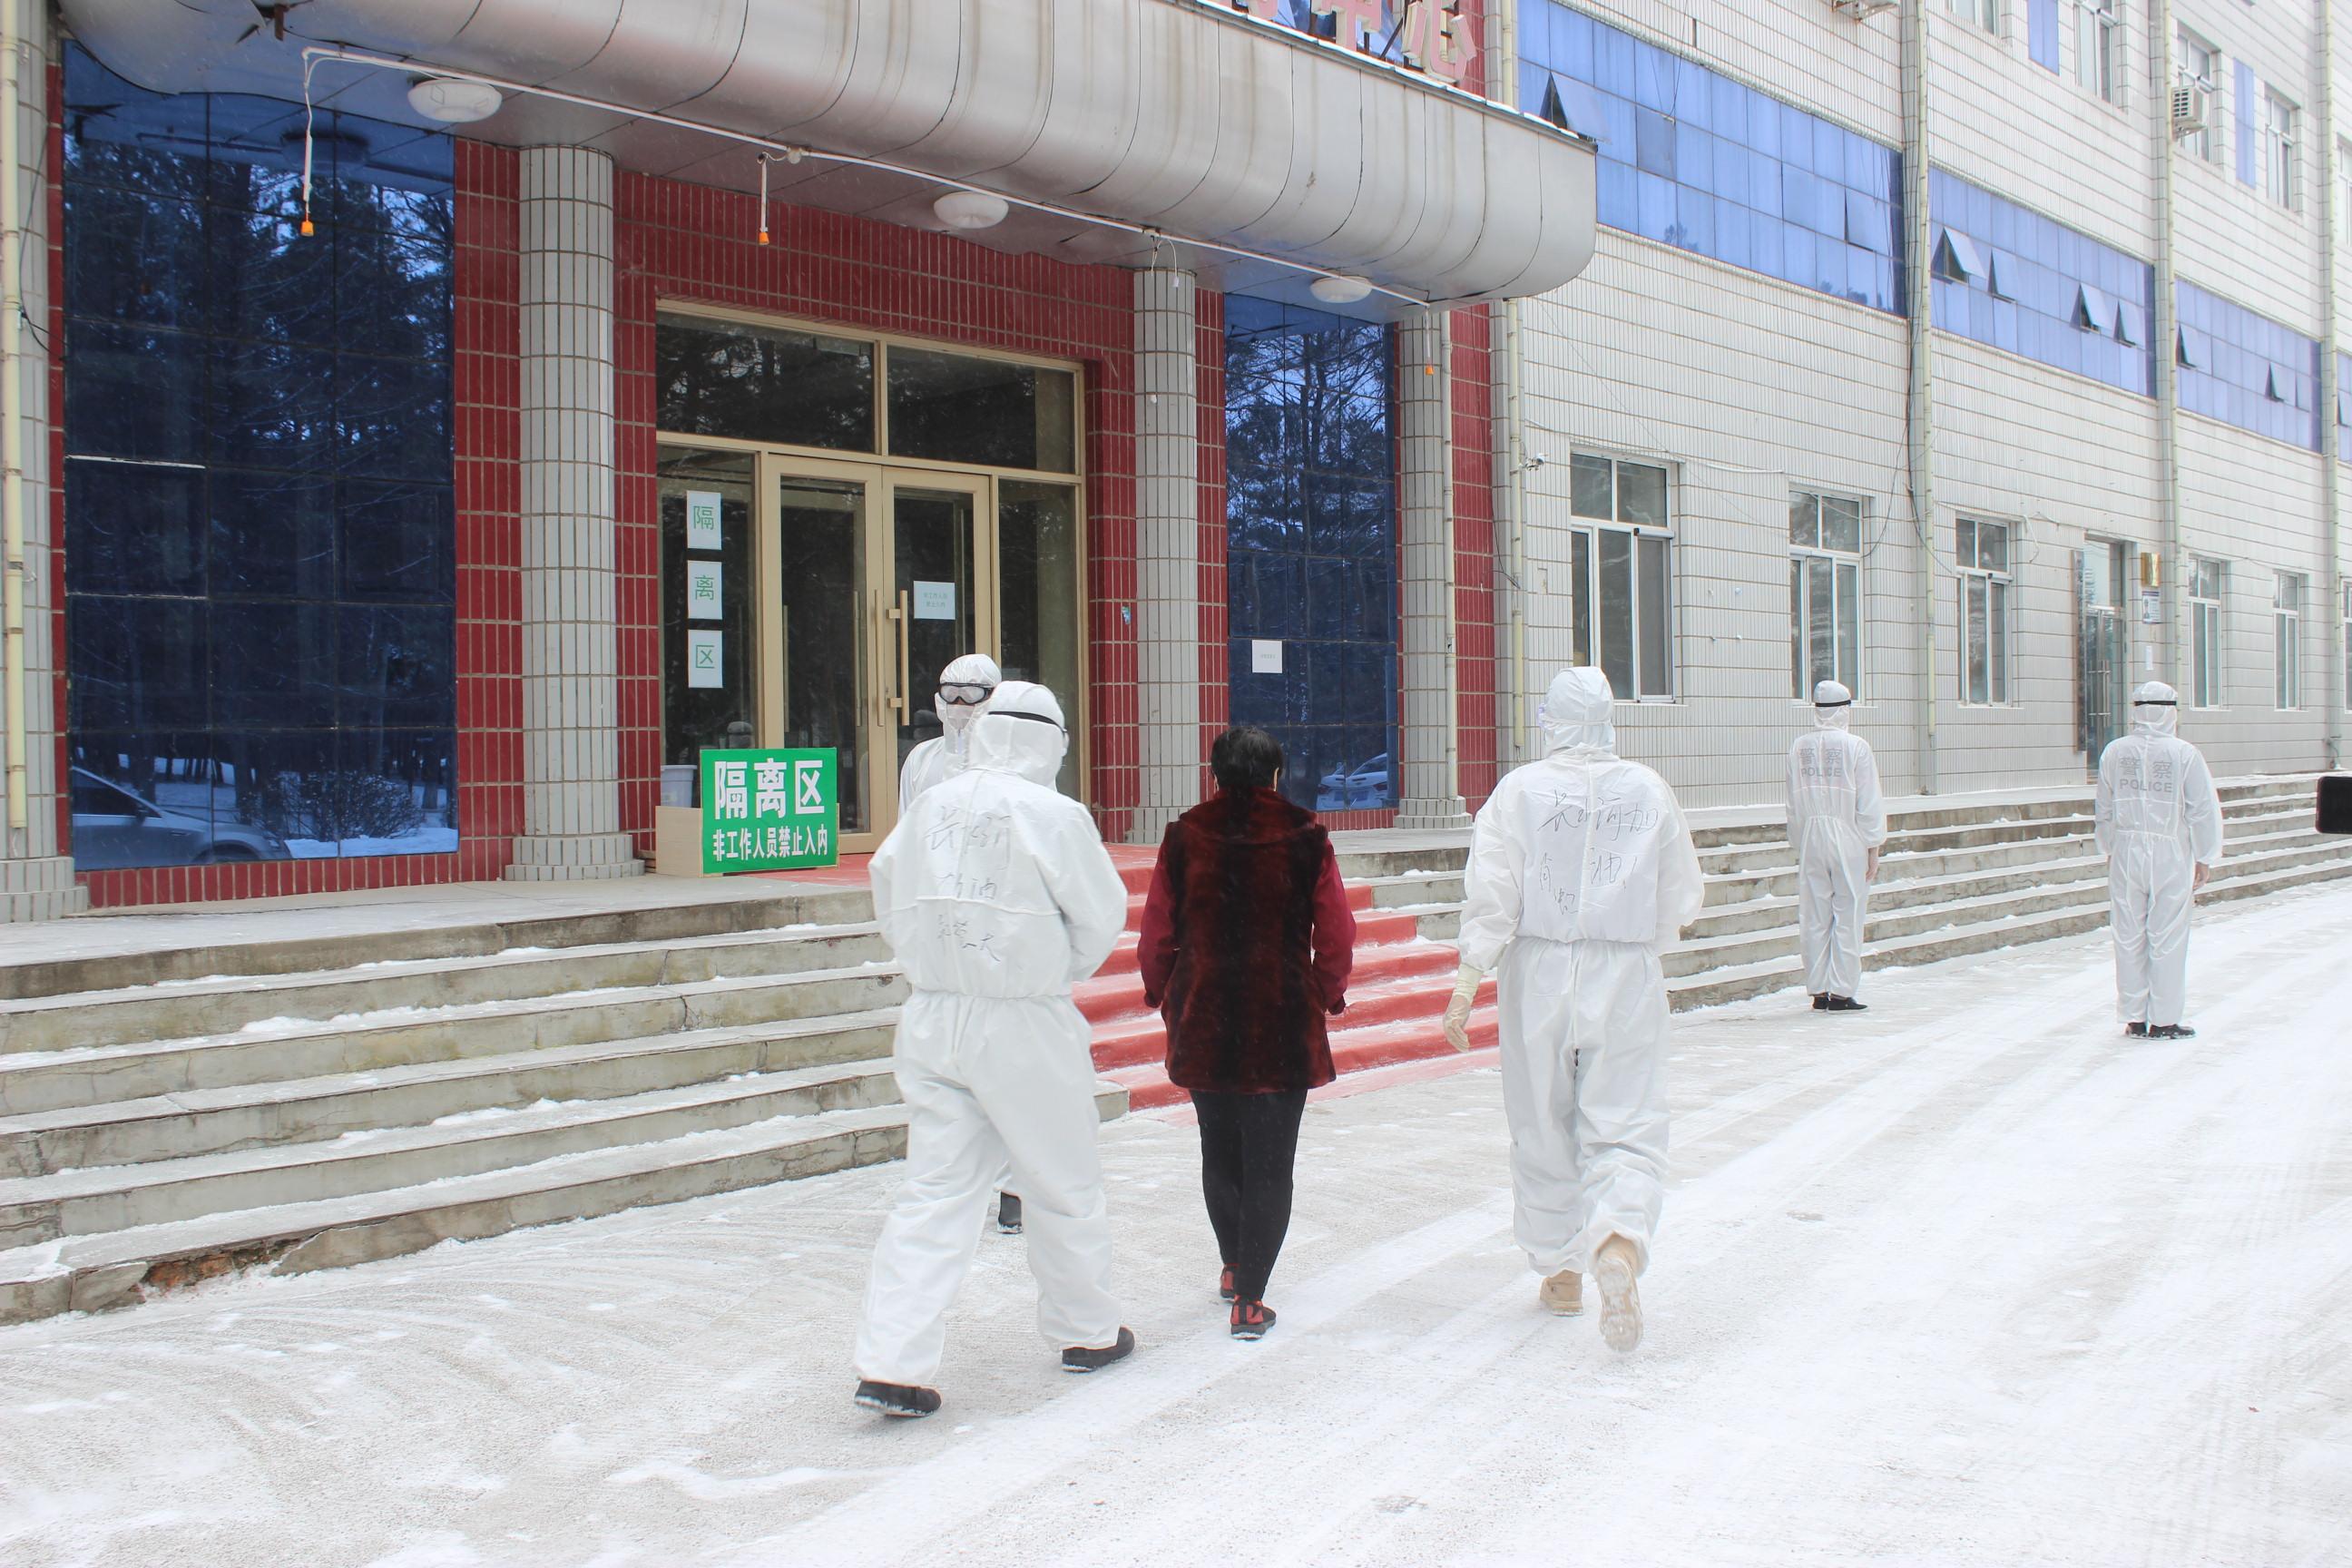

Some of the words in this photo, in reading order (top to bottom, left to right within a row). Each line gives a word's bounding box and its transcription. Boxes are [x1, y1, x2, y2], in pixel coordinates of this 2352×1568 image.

[1799, 748, 1842, 765] 警察
[2120, 757, 2172, 779] 警察
[714, 758, 825, 819] 隔离区
[2120, 779, 2172, 793] POLICE
[712, 823, 828, 862] 非工作人员禁止入内
